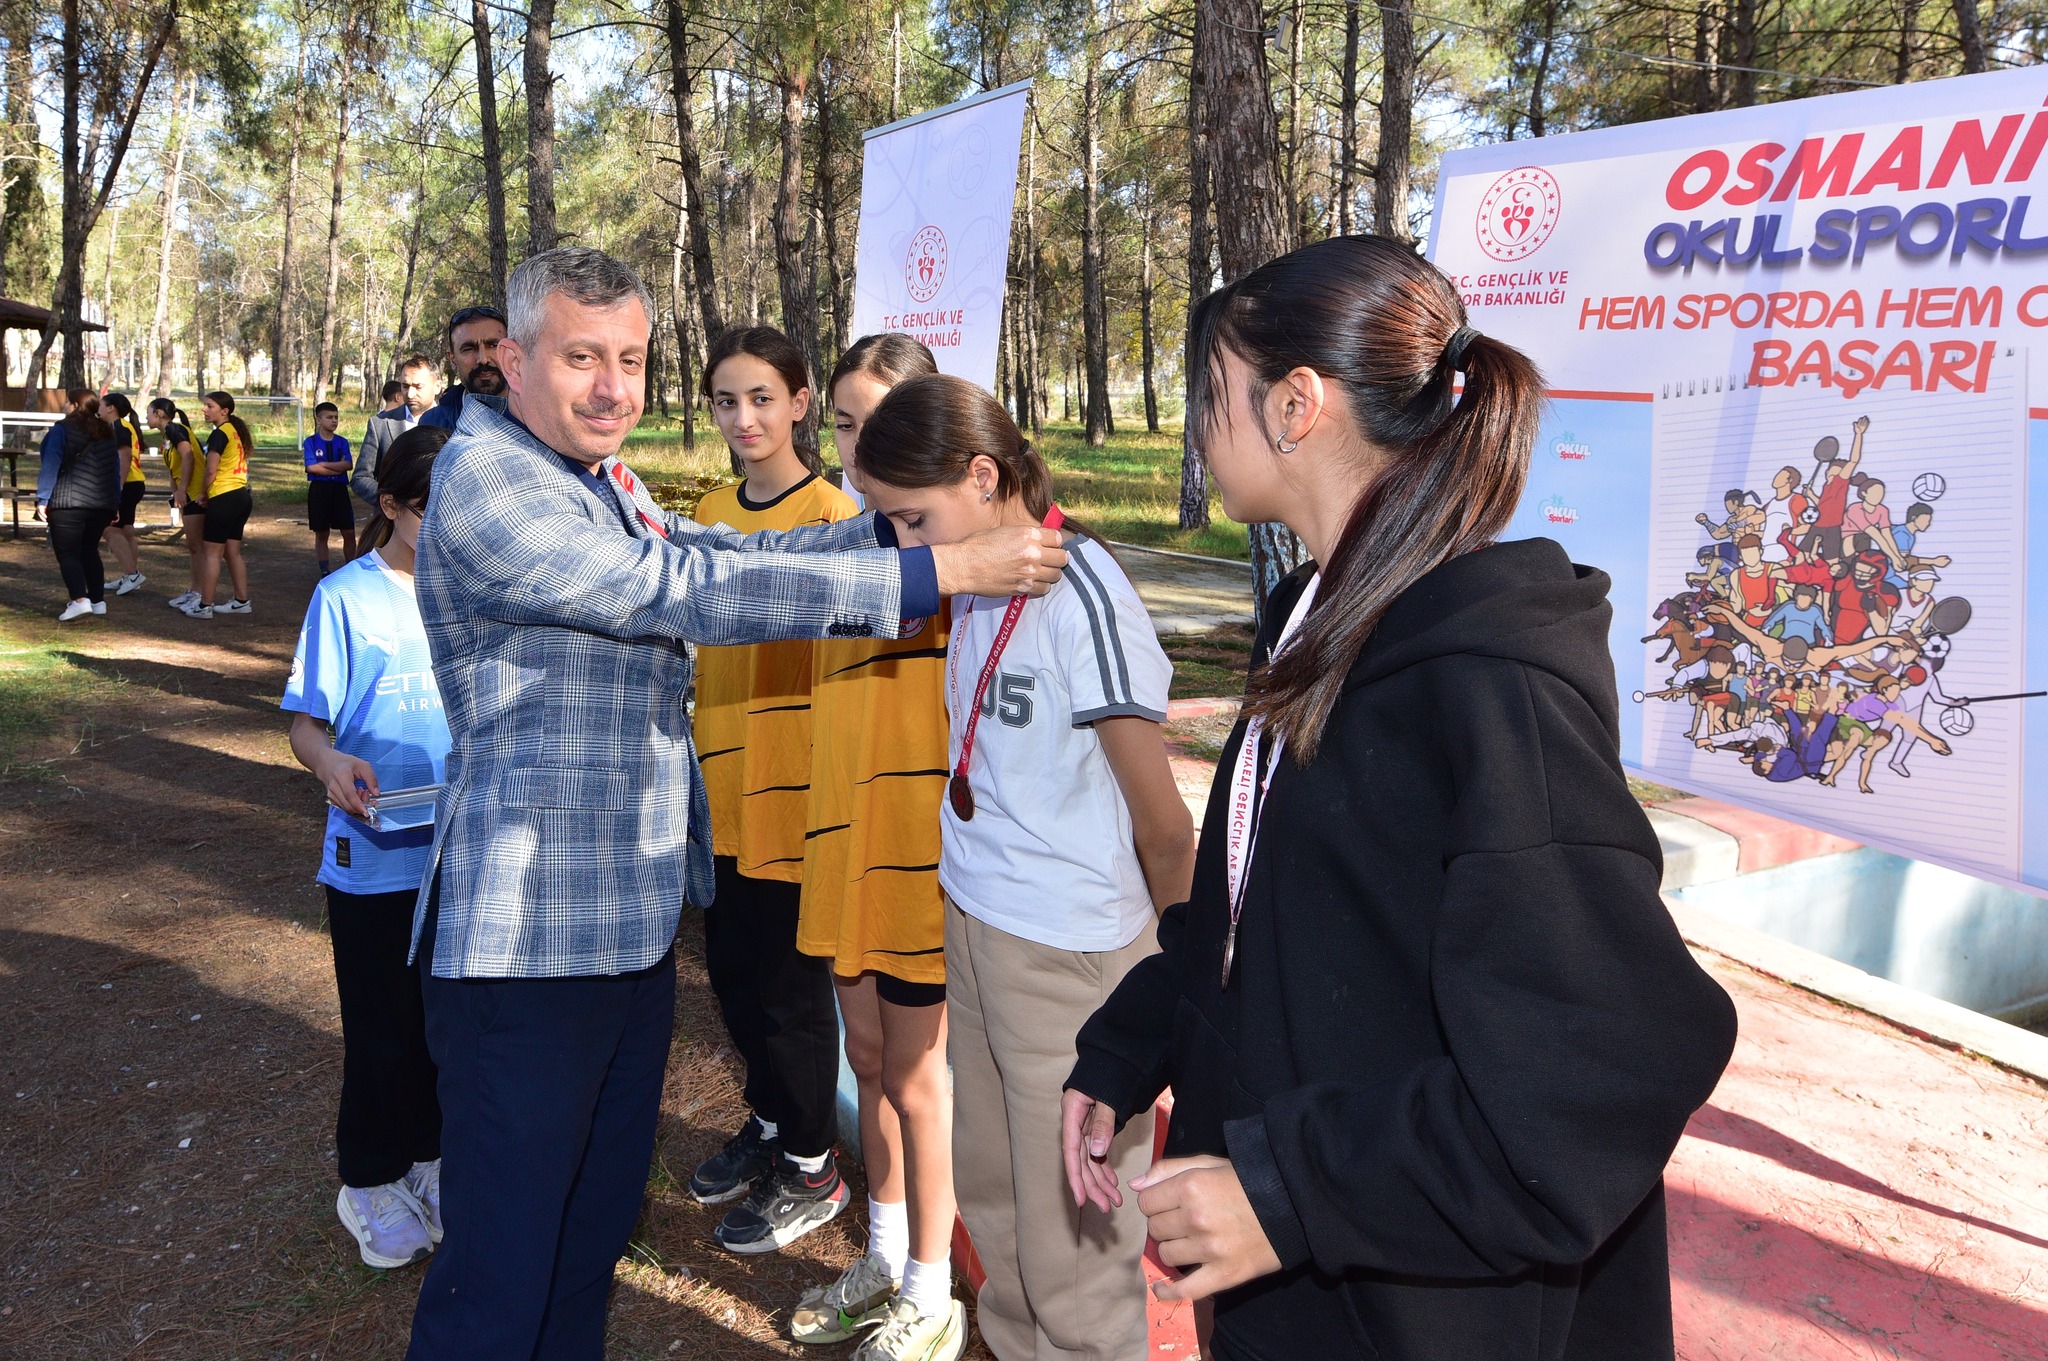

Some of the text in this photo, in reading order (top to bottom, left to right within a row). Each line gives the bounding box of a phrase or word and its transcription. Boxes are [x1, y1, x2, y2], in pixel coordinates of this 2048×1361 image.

[1665, 93, 2048, 211] OSMANİ
[1643, 195, 2048, 267] OKUL SPORL
[1477, 269, 1543, 290] GENÇLİK
[1548, 270, 1568, 285] VE
[1462, 288, 1565, 307] OR BAKANLIĞI
[1579, 295, 1665, 330] HEM
[1673, 289, 1864, 330] SPORDA
[1875, 285, 2003, 329] HEM
[884, 308, 963, 330] T.C. GENÇLİK VE
[1748, 339, 1996, 399] BAŞARI
[1556, 442, 1591, 456] OKUL
[1544, 505, 1579, 520] OKUL
[993, 620, 1012, 657] GENÇLİK
[1009, 607, 1018, 620] VE
